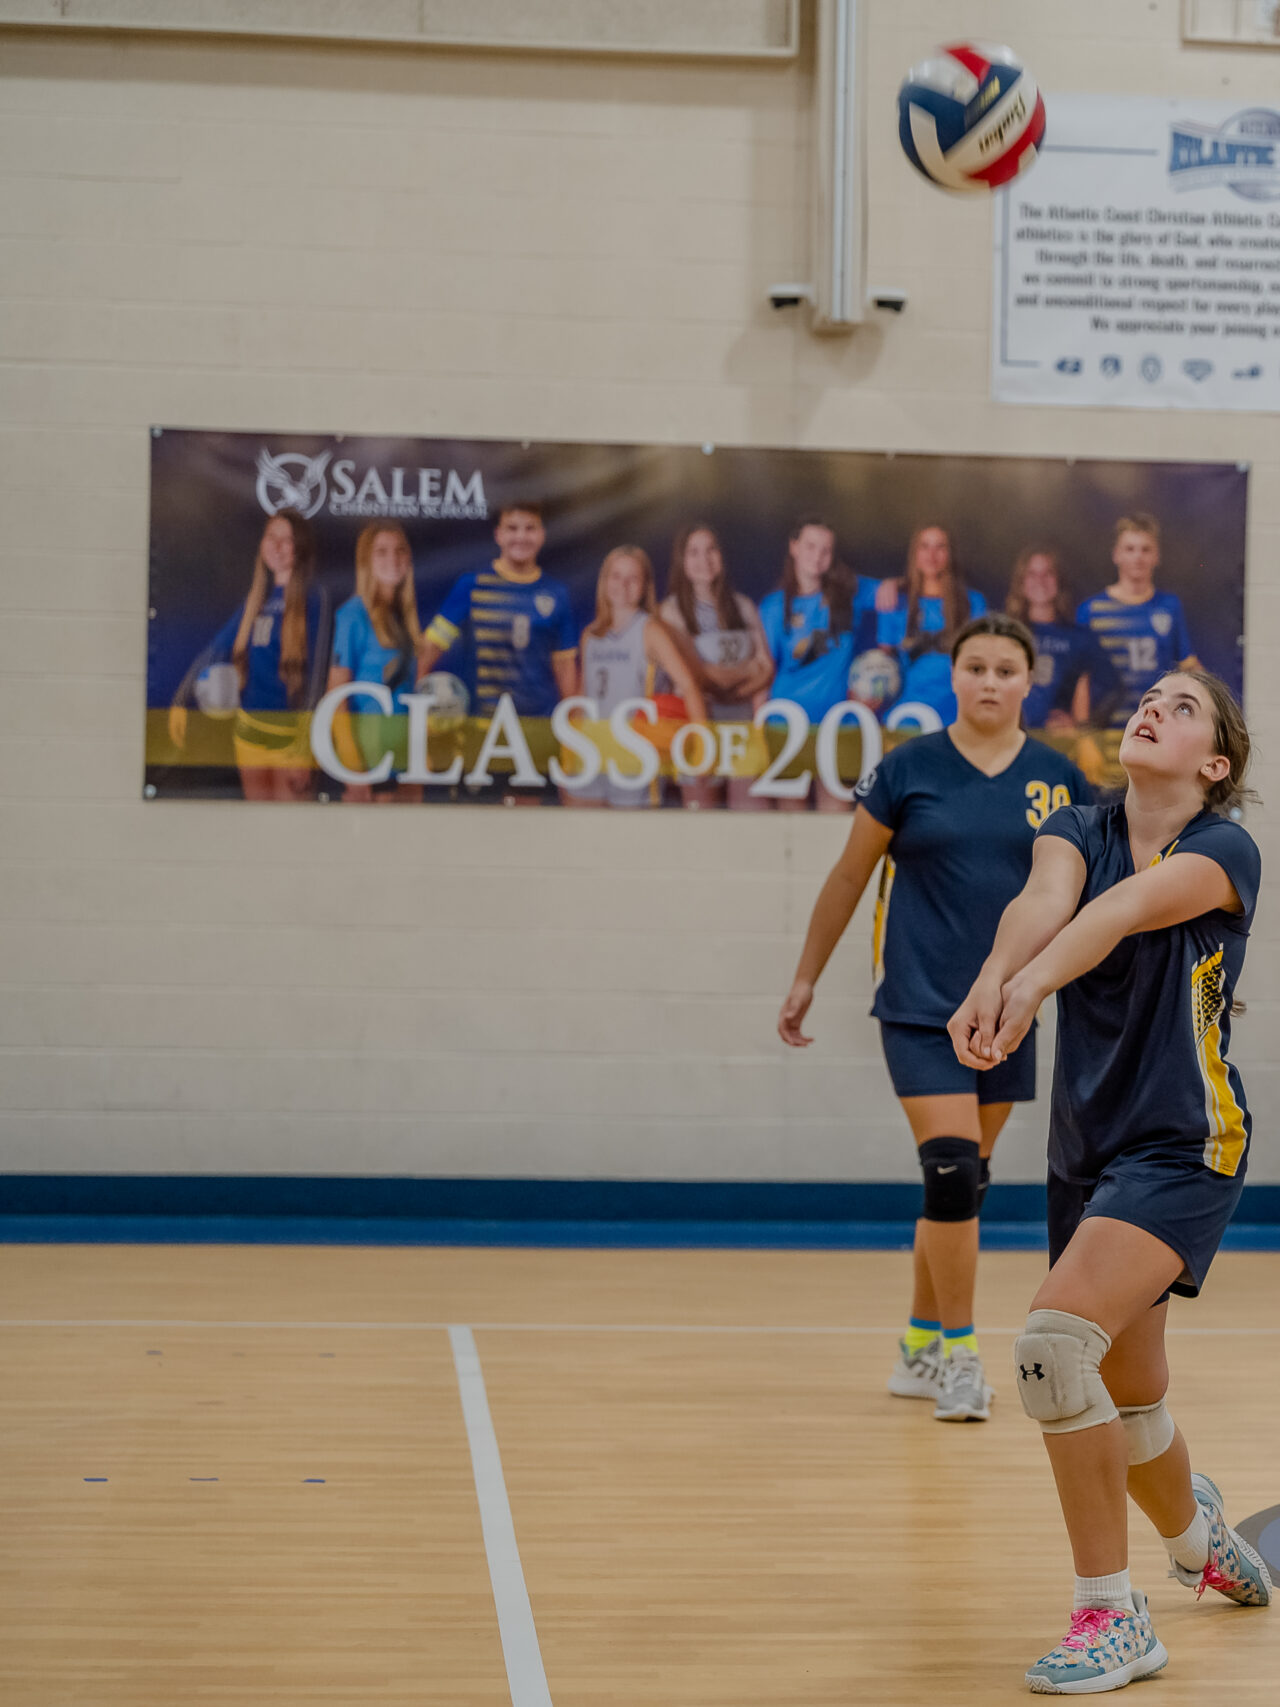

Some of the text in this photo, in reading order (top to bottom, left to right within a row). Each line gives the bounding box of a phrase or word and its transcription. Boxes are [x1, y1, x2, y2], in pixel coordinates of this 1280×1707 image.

[1170, 130, 1274, 173] ATLANTIC
[331, 459, 487, 505] SALEM
[329, 503, 419, 518] CHRISTIAN
[310, 681, 944, 800] CLASS OF 20
